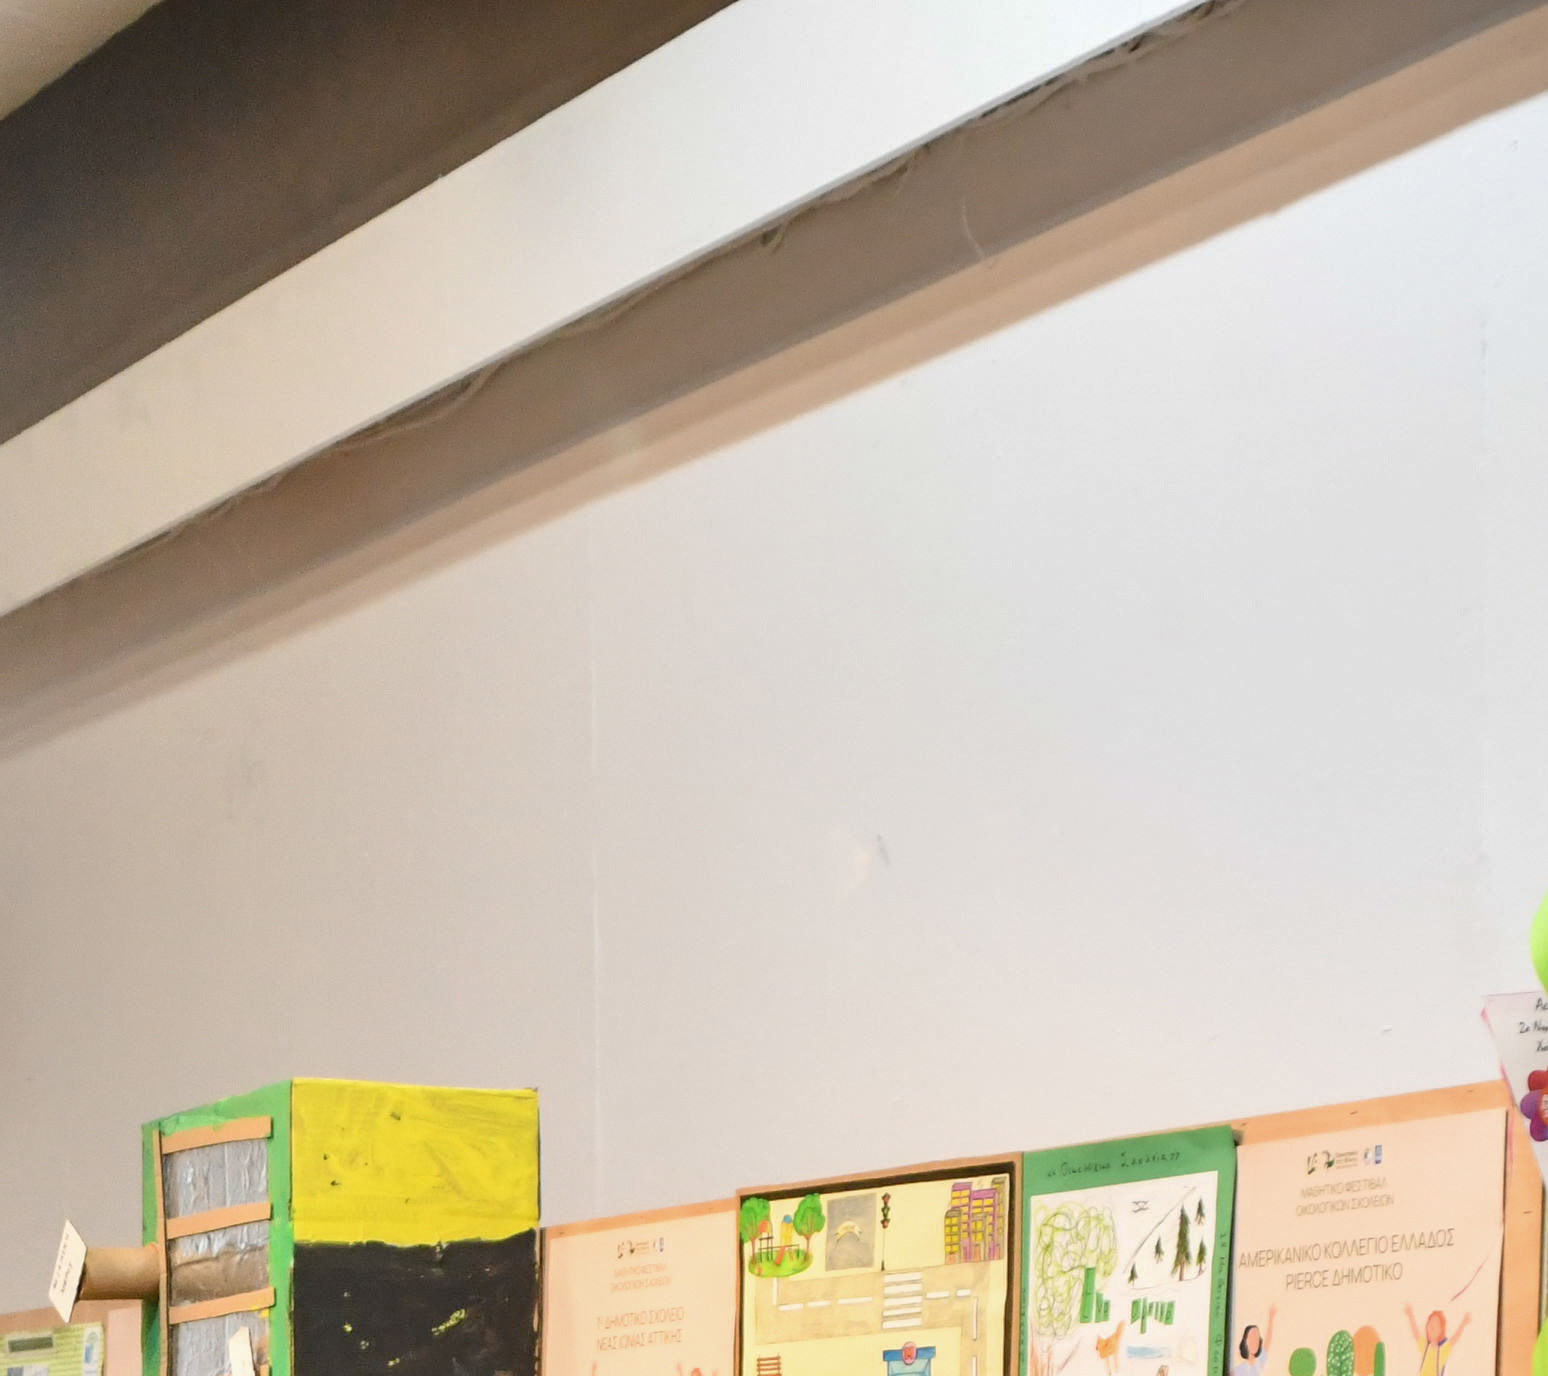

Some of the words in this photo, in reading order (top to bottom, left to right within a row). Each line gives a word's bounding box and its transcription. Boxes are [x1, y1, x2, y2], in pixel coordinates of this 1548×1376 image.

[1238, 1243, 1322, 1269] ΑΜΕΡΙΚΑΝΙΚΟ
[1323, 1236, 1388, 1259] ΚΟΛΛΕΓΙΟ
[1390, 1229, 1455, 1253] ΕΛΛΑΔΟΣ
[1285, 1269, 1329, 1291] PIERCE
[1332, 1262, 1403, 1286] ΔΗΜΟΤΙΚΟ
